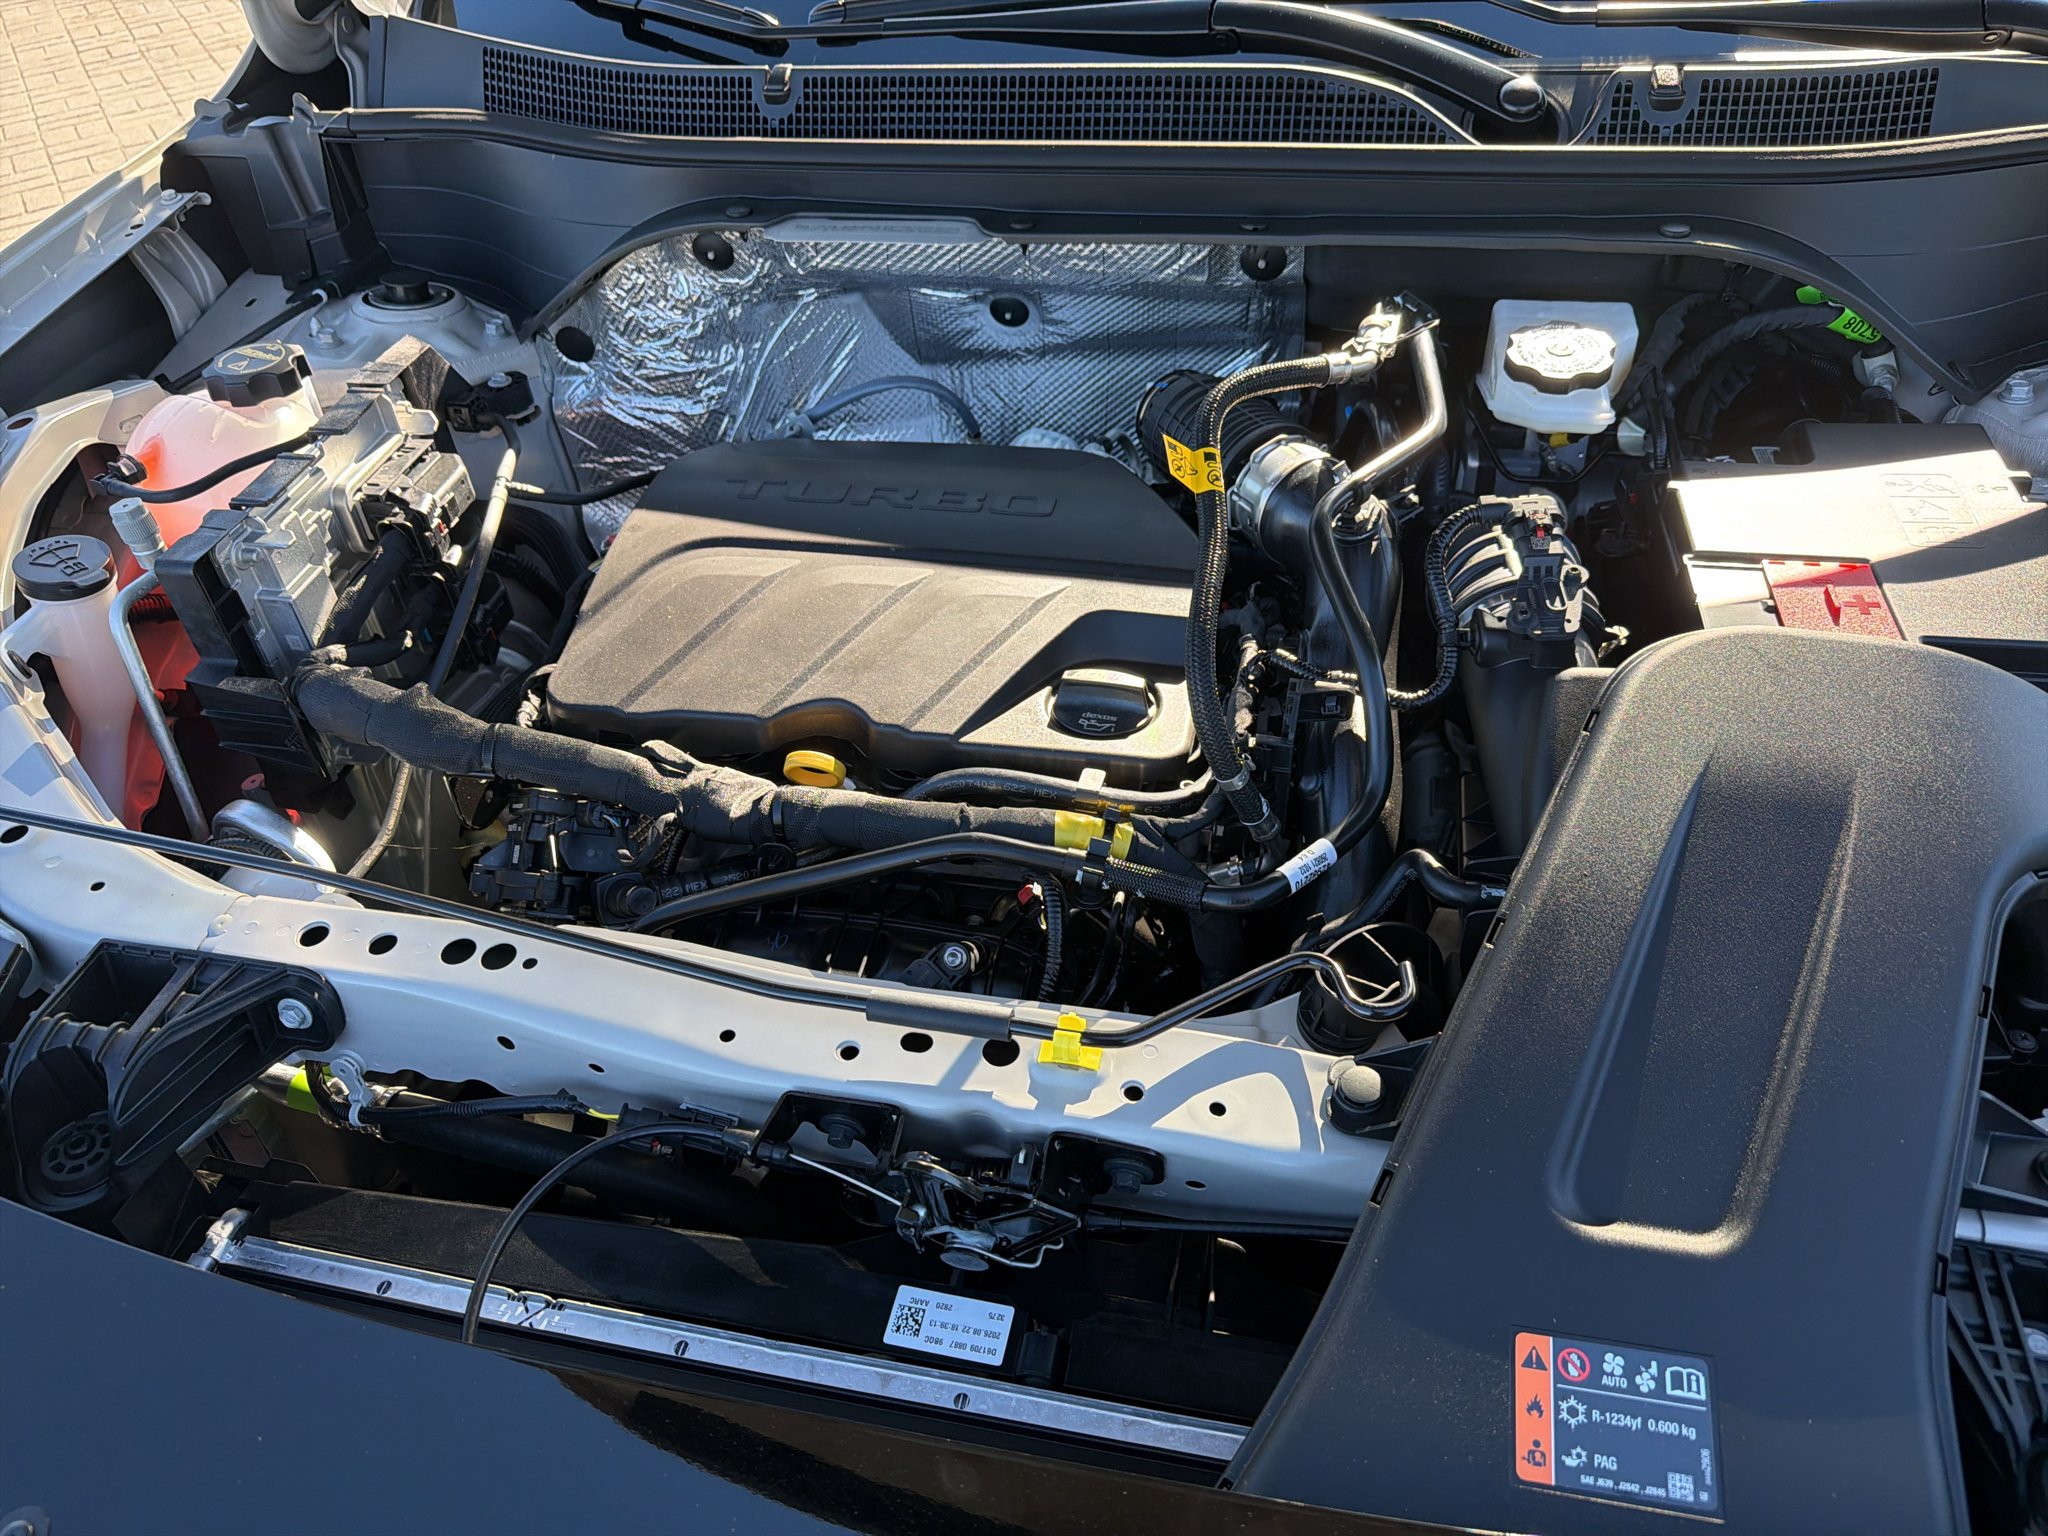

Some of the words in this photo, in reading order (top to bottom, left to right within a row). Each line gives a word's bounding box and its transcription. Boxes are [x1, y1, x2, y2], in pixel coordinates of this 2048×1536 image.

[726, 478, 1058, 518] TURBO
[1081, 711, 1119, 722] dexos
[1033, 786, 1059, 799] MEX
[685, 881, 709, 893] MEX
[909, 1296, 930, 1307] AARC
[935, 1302, 953, 1311] 2820
[988, 1312, 1006, 1322] 3275
[928, 1319, 959, 1331] 18:39:13
[961, 1325, 1002, 1340] 2026.08.22
[948, 1340, 968, 1351] 0887
[969, 1345, 997, 1356] D61709
[1601, 1375, 1628, 1389] AUTO
[1592, 1409, 1642, 1431] R-1234yf
[1648, 1418, 1680, 1436] 0.600
[1681, 1424, 1697, 1441] kg
[1594, 1454, 1618, 1470] PAG
[1580, 1474, 1595, 1485] SAE
